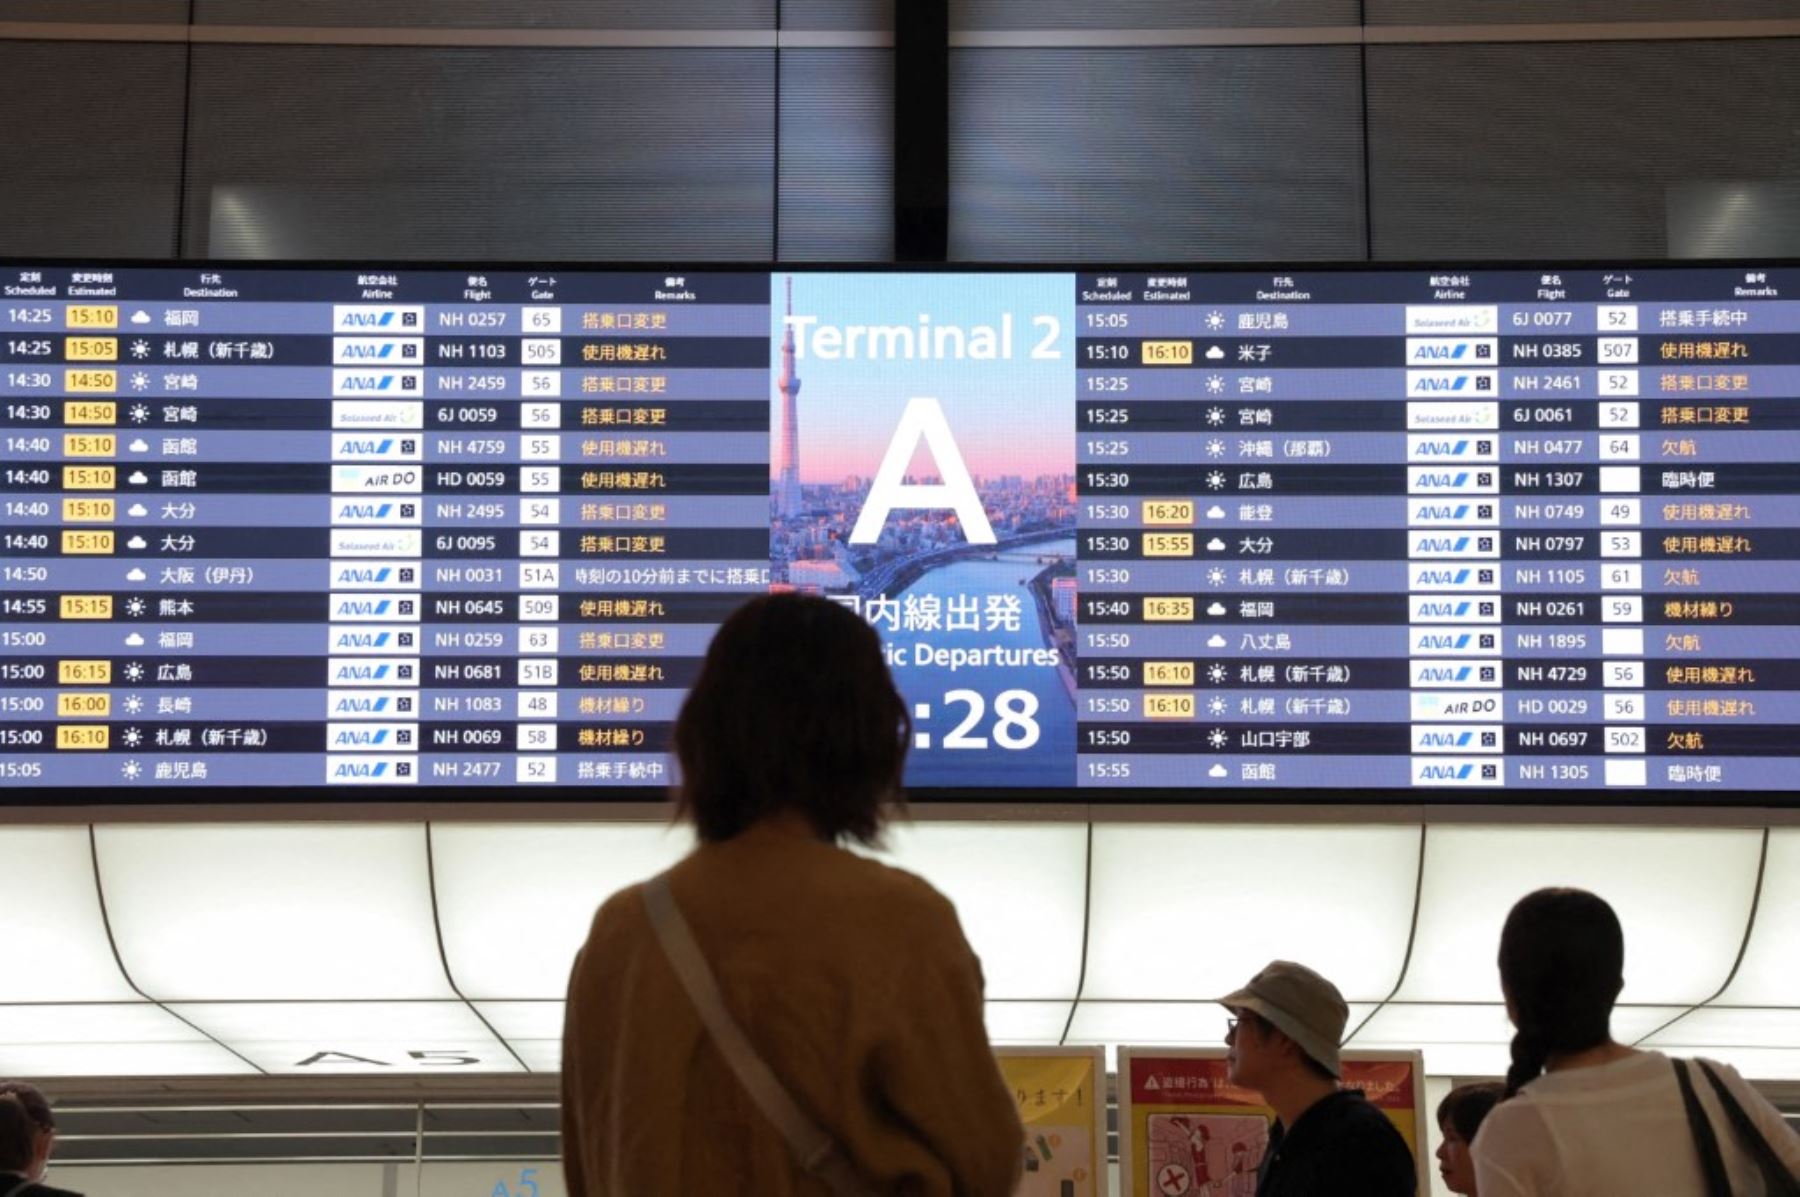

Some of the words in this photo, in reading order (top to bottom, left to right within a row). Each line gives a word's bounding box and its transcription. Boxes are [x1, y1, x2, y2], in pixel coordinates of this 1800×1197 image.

[527, 276, 557, 287] ゲート
[1602, 274, 1633, 285] ゲート
[4, 285, 57, 296] Scheduled
[67, 285, 117, 296] Estimated
[183, 287, 238, 298] Destination
[361, 289, 393, 299] Airline
[463, 289, 491, 302] Flight
[531, 289, 554, 300] Gate
[654, 290, 697, 300] Remarks
[1082, 290, 1132, 301] Scheduled
[1143, 290, 1191, 301] Estimated
[1256, 290, 1311, 300] Destination
[1434, 289, 1465, 300] Airline
[1537, 288, 1566, 301] Flight
[1606, 288, 1630, 298] Gate
[1734, 286, 1778, 296] Remarks
[783, 313, 1012, 360] Terminal
[1031, 315, 1062, 360] 2
[8, 340, 52, 355] 14:25
[72, 341, 113, 356] 15:05
[341, 344, 376, 359] ANA
[438, 344, 463, 358] NH
[469, 344, 506, 359] 1103
[527, 344, 556, 359] 505
[582, 344, 666, 361] 使用機遅れ
[1087, 344, 1129, 360] 15:10
[1148, 345, 1188, 359] 16:10
[1237, 344, 1272, 362] 米子
[1414, 345, 1449, 360] ANA
[1513, 343, 1538, 358] NH
[1542, 343, 1582, 358] 0385
[1603, 343, 1632, 358] 507
[1660, 341, 1748, 359] 使用機遅れ
[7, 404, 51, 420] 14:30
[71, 405, 112, 420] 14:50
[162, 405, 198, 423] 宮崎
[437, 407, 454, 422] 6J
[458, 407, 497, 423] 0059
[531, 408, 551, 423] 56
[581, 407, 666, 425] 搭乗口変更
[1087, 408, 1129, 424] 15:25
[1238, 408, 1273, 426] 宮崎
[1513, 408, 1530, 423] 6J
[1534, 407, 1572, 423] 0061
[1609, 406, 1629, 422] 52
[1661, 406, 1749, 424] 搭乗口変更
[6, 469, 50, 484] 14:40
[69, 470, 111, 484] 15:10
[161, 469, 198, 488] 函館
[531, 471, 550, 486] 55
[848, 397, 998, 545] A
[364, 474, 388, 487] AIR
[392, 471, 415, 486] DO
[437, 471, 463, 486] HD
[466, 471, 504, 487] 0059
[581, 471, 666, 489] 使用機遅れ
[1087, 473, 1130, 488] 15:30
[1238, 471, 1273, 490] 広島
[1415, 474, 1451, 488] ANA
[1514, 472, 1540, 487] NH
[1545, 471, 1583, 487] 1307
[1661, 471, 1715, 489] 臨時便
[1238, 503, 1273, 522] 能登
[4, 534, 49, 549] 14:40
[68, 535, 109, 549] 15:10
[160, 534, 196, 552] 大分
[436, 535, 453, 550] 6J
[456, 536, 495, 551] 0095
[530, 536, 549, 551] 54
[580, 535, 665, 553] 搭乗口変更
[1087, 536, 1130, 551] 15:30
[1148, 537, 1189, 551] 15:55
[1239, 536, 1274, 554] 大分
[1416, 538, 1452, 553] ANA
[1515, 536, 1541, 551] NH
[1544, 536, 1584, 551] 0797
[1611, 536, 1631, 551] 53
[1663, 535, 1751, 554] 使用機遅れ
[3, 598, 46, 614] 14:55
[66, 599, 108, 614] 15:15
[159, 598, 194, 616] 熊本
[337, 601, 373, 615] ANA
[435, 600, 461, 615] NH
[464, 600, 502, 615] 0645
[525, 600, 553, 614] 509
[579, 599, 665, 617] 使用機遅れ
[1087, 601, 1130, 616] 15:40
[1149, 602, 1190, 616] 16:35
[1239, 600, 1275, 618] 福岡
[1417, 603, 1453, 617] ANA
[1516, 601, 1542, 616] NH
[1545, 601, 1584, 616] 0261
[1612, 601, 1632, 616] 59
[1240, 633, 1292, 651] 八丈島
[914, 642, 1060, 671] Departures
[1, 664, 45, 679] 15:00
[64, 664, 107, 679] 16:15
[156, 663, 193, 681] 広島
[336, 666, 372, 680] ANA
[434, 664, 460, 679] NH
[463, 664, 501, 679] 0681
[523, 664, 553, 679] 51B
[578, 664, 663, 682] 使用機遅れ
[1088, 665, 1131, 681] 15:50
[1149, 666, 1190, 680] 16:10
[1418, 668, 1453, 682] ANA
[1517, 666, 1543, 681] NH
[1547, 666, 1587, 681] 4729
[1614, 666, 1634, 681] 56
[1666, 666, 1755, 684] 使用機遅れ
[157, 696, 192, 714] 長崎
[914, 688, 1041, 750] :28
[0, 729, 43, 745] 15:00
[63, 729, 106, 744] 16:10
[335, 731, 370, 745] ANA
[433, 729, 458, 744] NH
[462, 729, 500, 744] 0069
[527, 729, 548, 744] 58
[1088, 730, 1131, 746] 15:50
[1241, 730, 1311, 748] 山口宇部
[1419, 732, 1454, 747] ANA
[1519, 731, 1544, 746] NH
[1548, 731, 1588, 746] 0697
[1610, 731, 1639, 746] 502
[1667, 731, 1704, 750] 欠航
